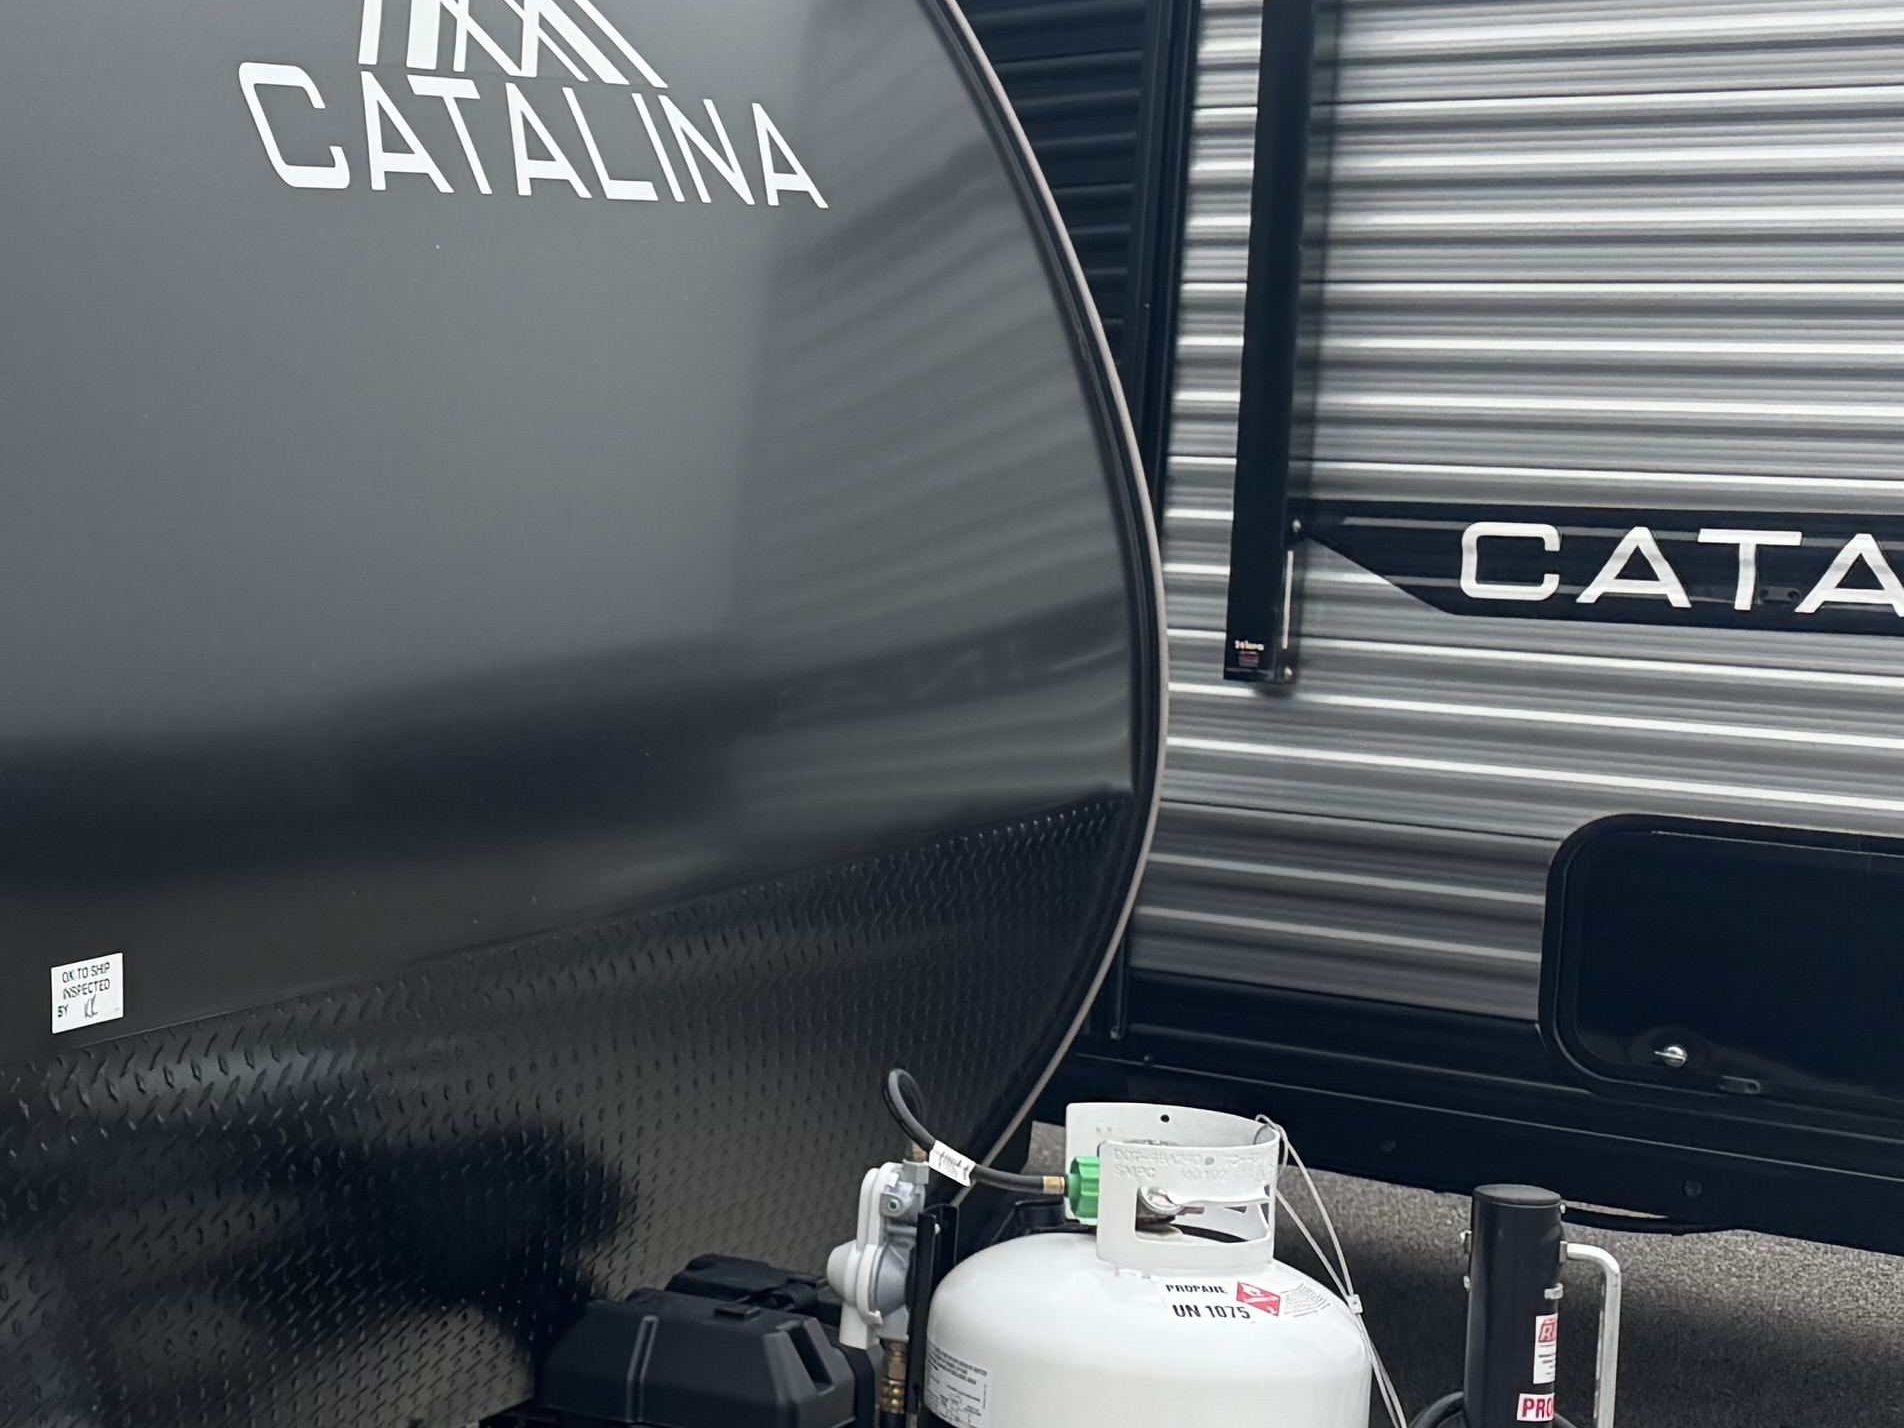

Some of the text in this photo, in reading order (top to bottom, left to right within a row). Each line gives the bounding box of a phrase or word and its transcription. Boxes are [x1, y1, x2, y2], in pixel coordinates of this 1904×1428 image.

[238, 62, 829, 209] CATALINA
[77, 967, 89, 979] TO
[91, 961, 111, 977] SHIP
[62, 978, 111, 1000] INSPECTED
[1164, 1283, 1229, 1295] PROPANE
[1171, 1304, 1251, 1320] UN 1075
